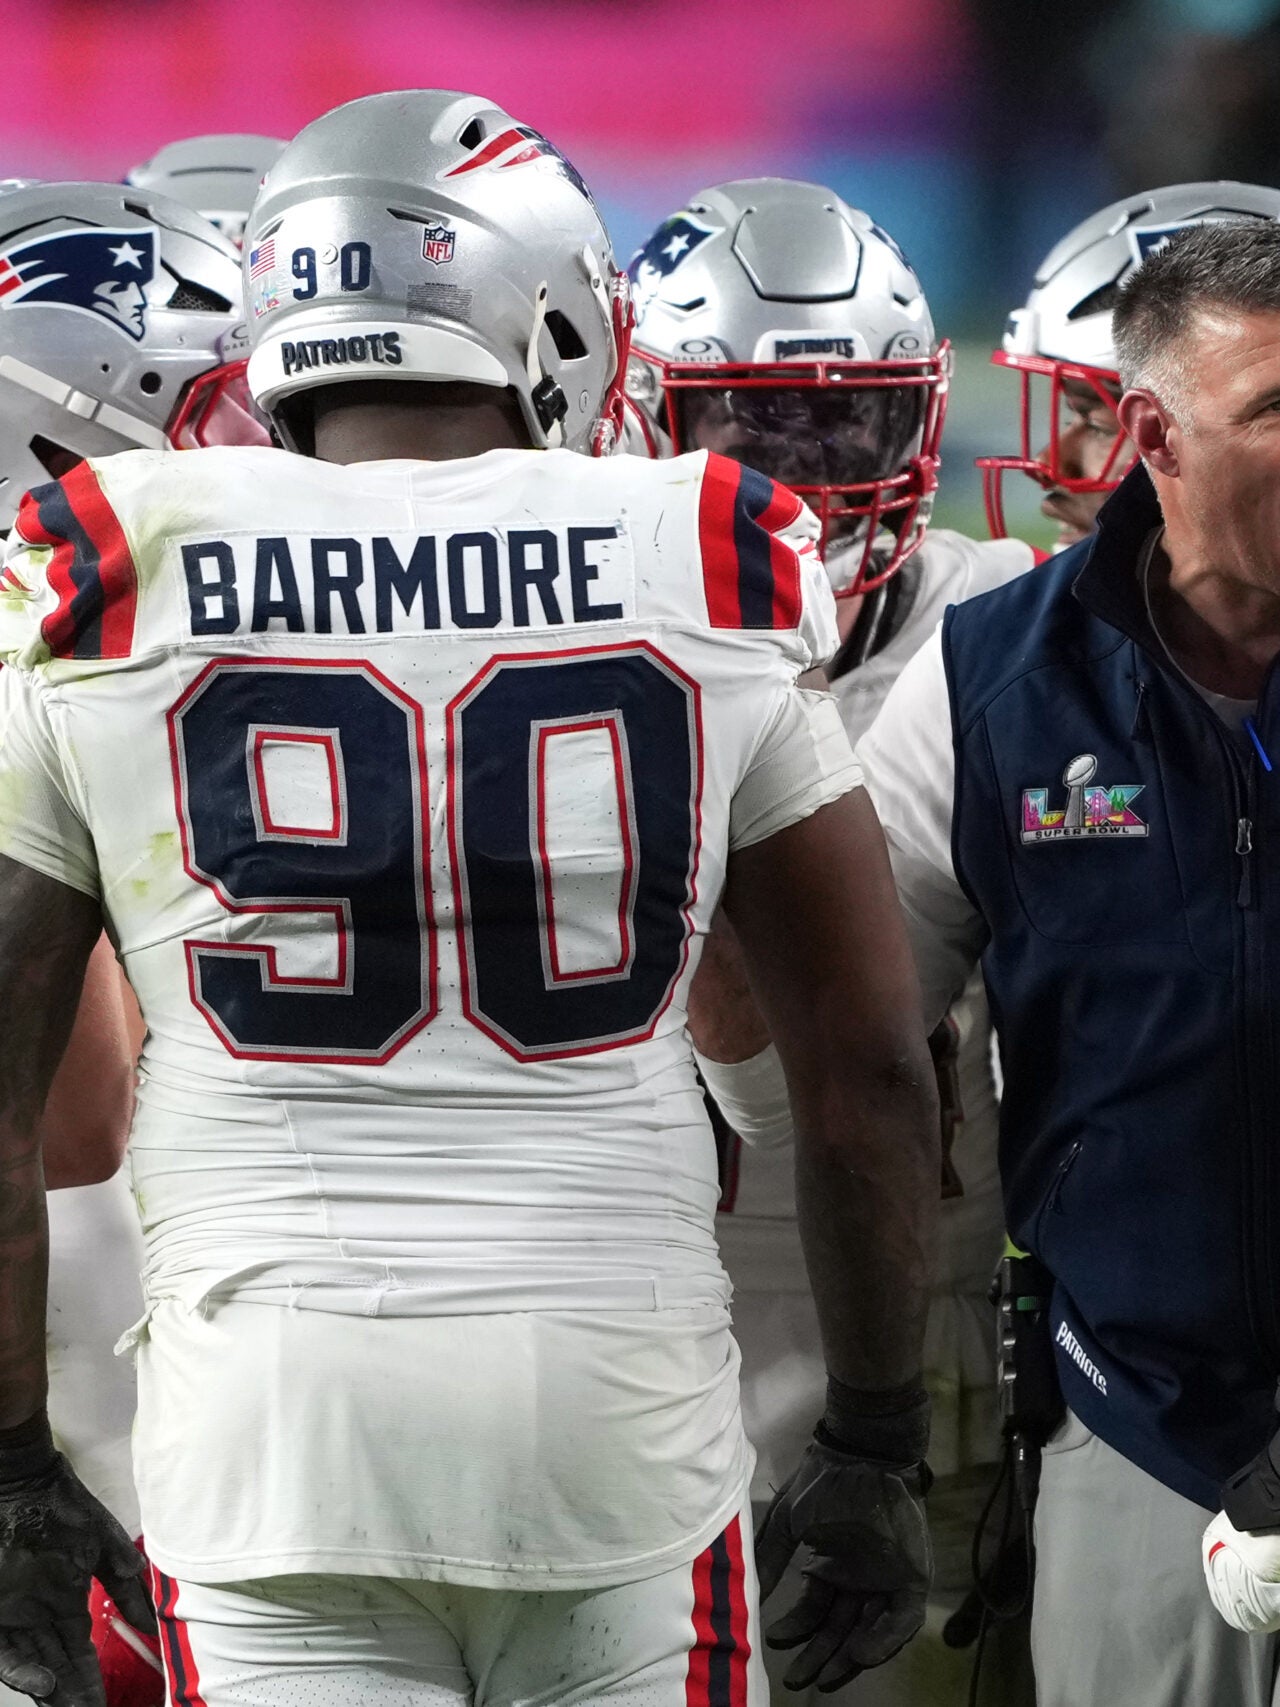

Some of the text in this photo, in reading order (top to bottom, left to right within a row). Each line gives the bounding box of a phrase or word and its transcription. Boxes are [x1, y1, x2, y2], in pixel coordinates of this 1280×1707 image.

[291, 241, 372, 301] 90
[425, 240, 452, 260] NFL
[281, 331, 403, 376] PATRIOTS
[181, 526, 624, 636] BARMORE
[166, 639, 704, 1064] 90
[1034, 825, 1130, 840] SUPER BOWL
[1055, 1320, 1108, 1396] PATRIOTS
